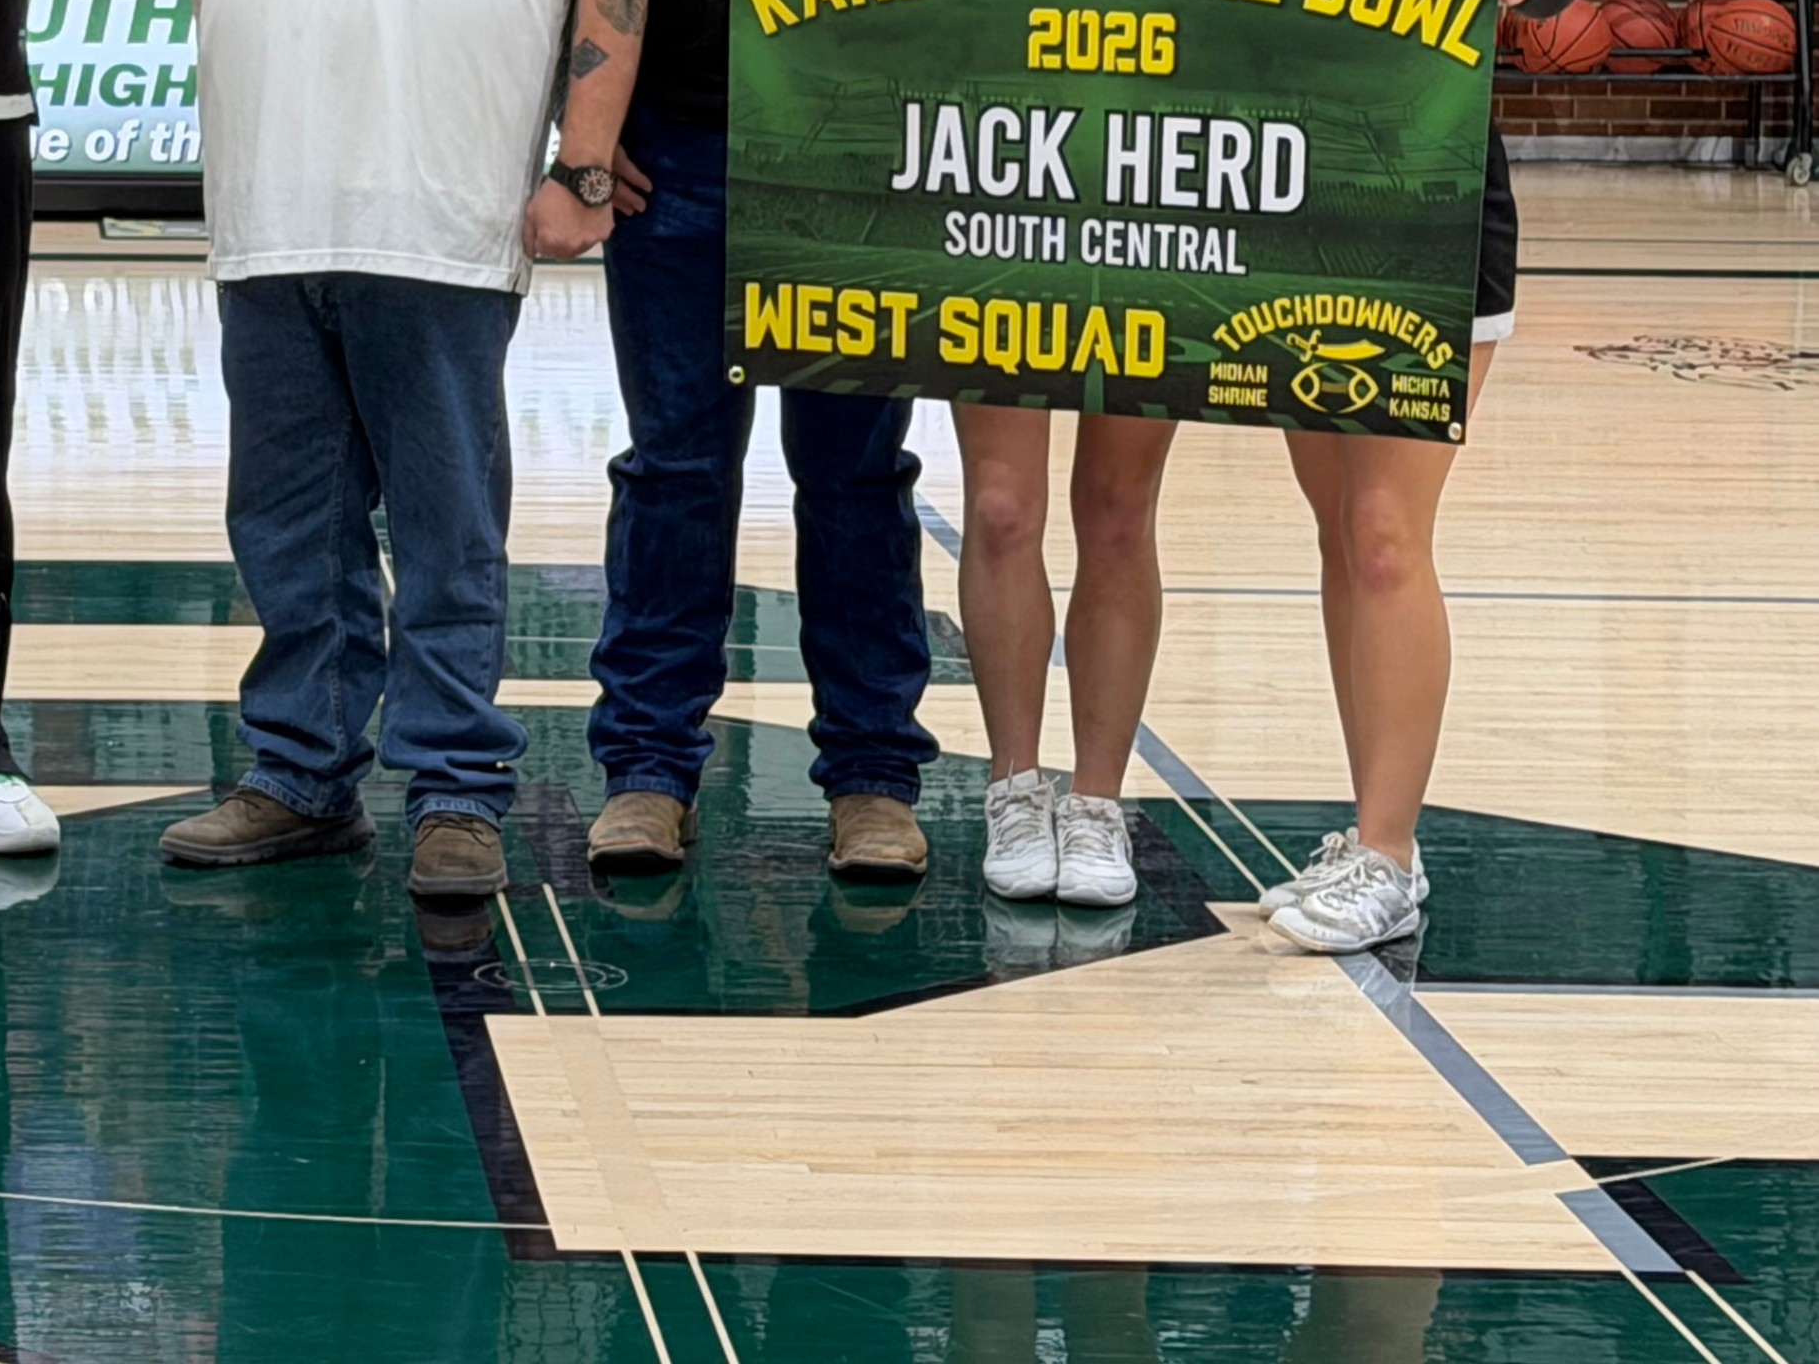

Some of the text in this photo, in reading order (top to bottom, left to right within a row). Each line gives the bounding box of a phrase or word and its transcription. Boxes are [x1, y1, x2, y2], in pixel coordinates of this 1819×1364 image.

[1027, 7, 1177, 76] 2026
[84, 122, 145, 164] of
[891, 102, 1309, 214] JACK HERD
[944, 209, 1247, 276] SOUTH CENTRAL
[744, 282, 1166, 379] WEST SQUAD
[1212, 294, 1454, 370] TOUCHDOWNERS
[1208, 385, 1268, 408] SHRINE
[1209, 362, 1269, 384] MIDIAN
[1391, 374, 1451, 399] WICHITA
[1388, 399, 1451, 422] KANSAS
